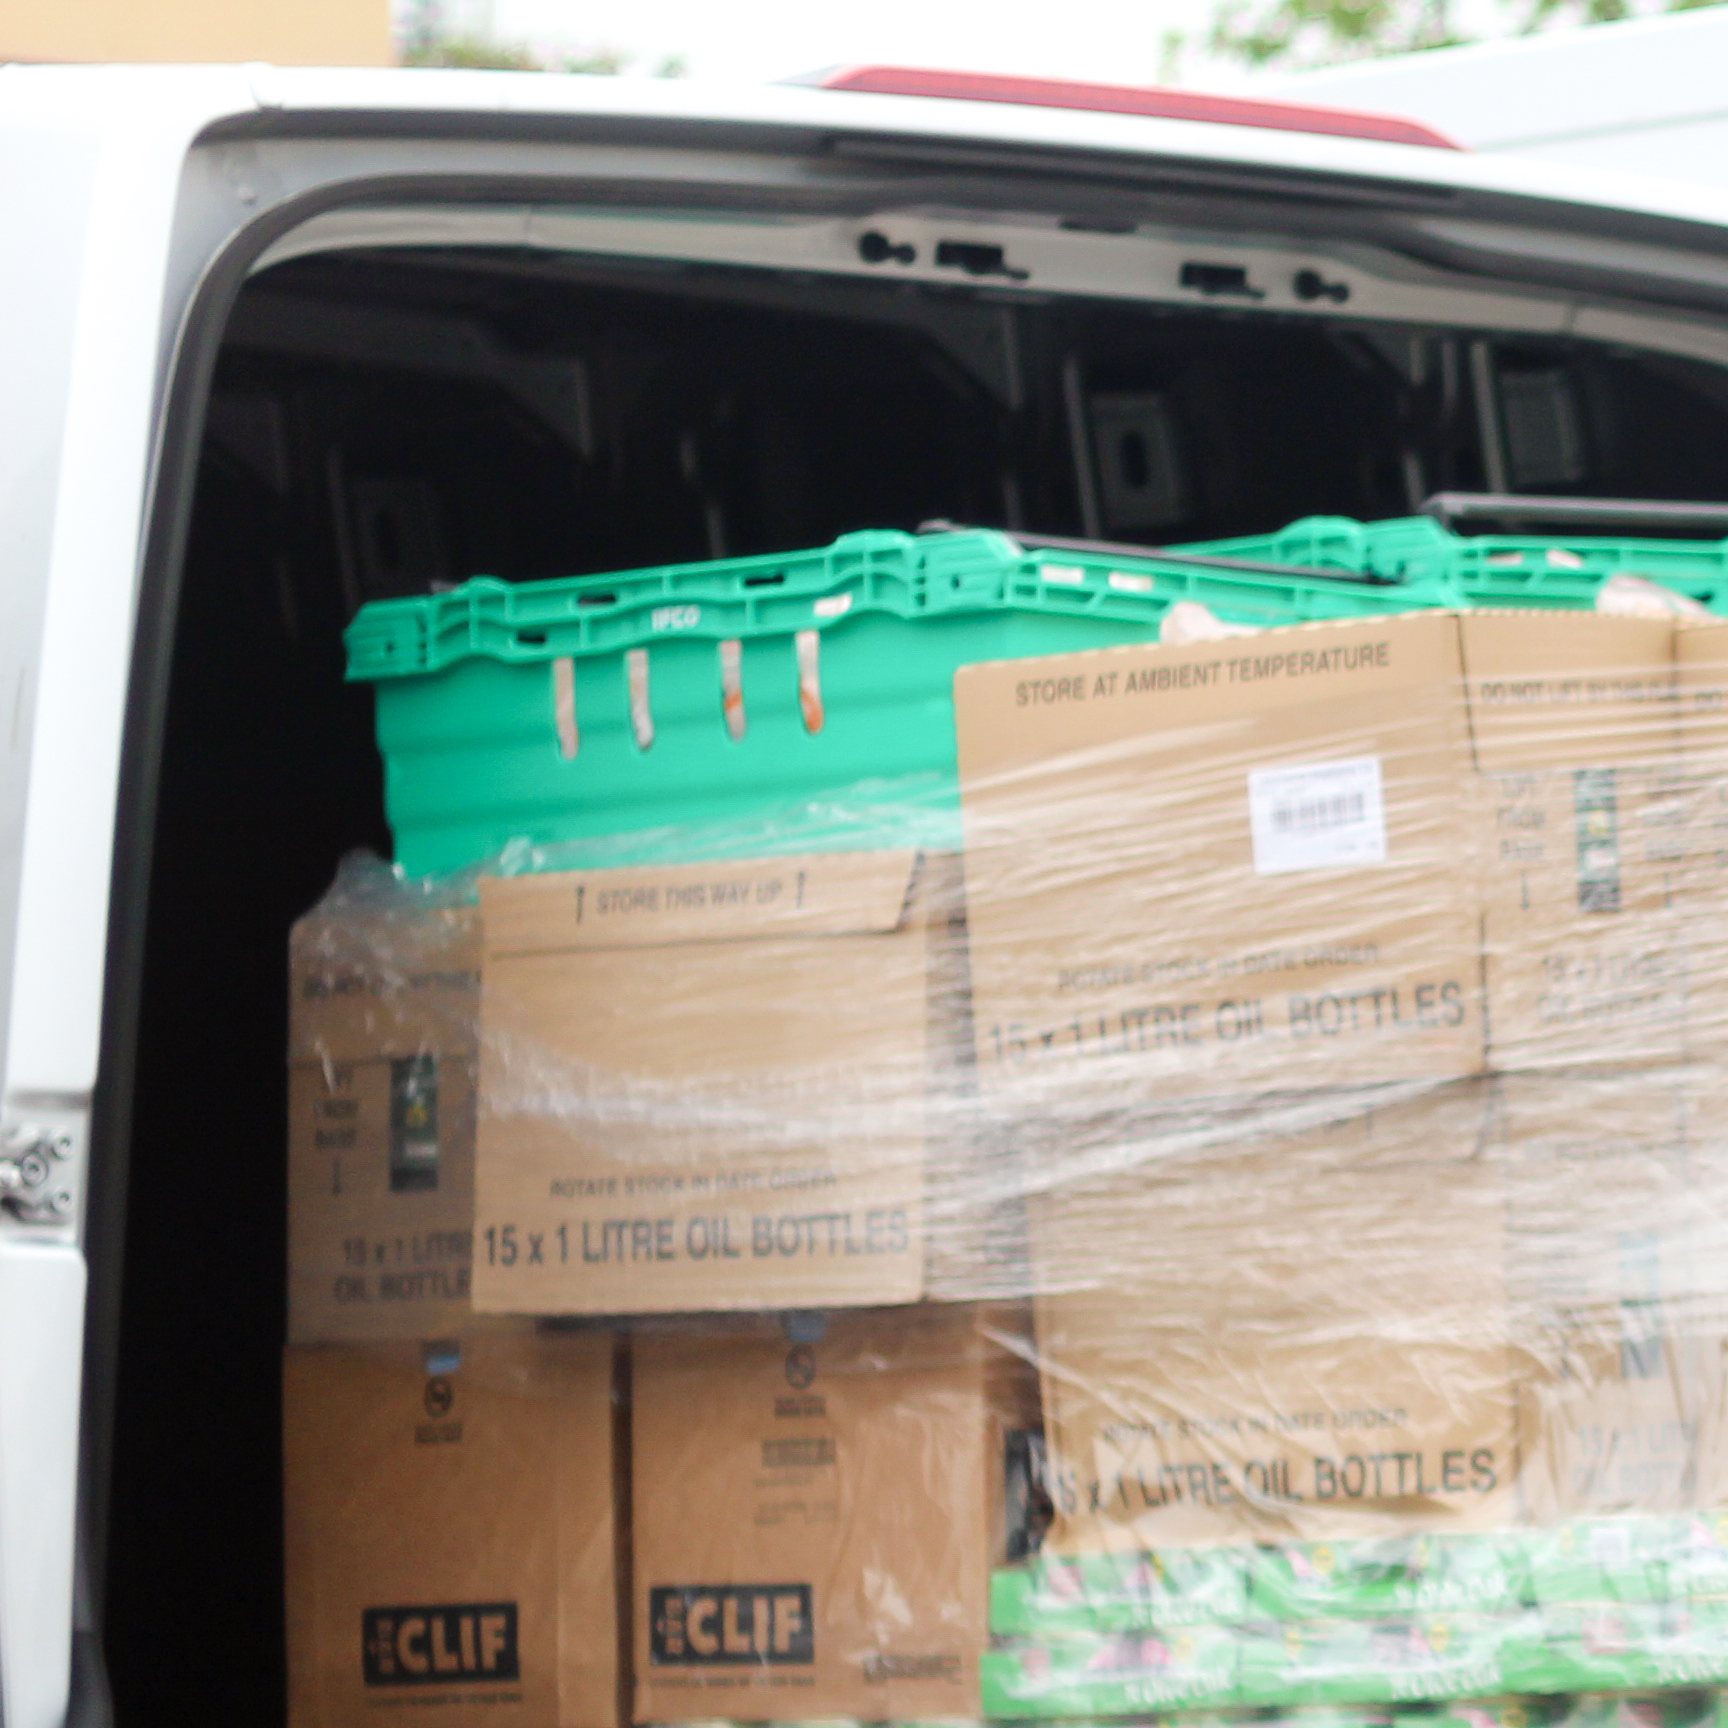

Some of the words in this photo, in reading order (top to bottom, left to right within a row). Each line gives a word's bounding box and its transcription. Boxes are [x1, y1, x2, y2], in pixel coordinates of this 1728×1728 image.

[1016, 675, 1085, 706] STORE
[1093, 672, 1118, 698] AT
[1125, 661, 1221, 694] AMBIENT
[1228, 642, 1391, 682] TEMPERATURE
[598, 887, 658, 914] STORE
[666, 885, 704, 911] THIS
[711, 880, 749, 906] WAY
[757, 879, 783, 904] UP
[990, 1023, 1026, 1066] 15
[1069, 1017, 1082, 1055] 1
[1100, 1003, 1202, 1056] LITRE
[1216, 1001, 1274, 1044] OIL
[1288, 981, 1465, 1039] BOTTLES
[484, 1225, 518, 1267] 15
[528, 1232, 544, 1265] x
[556, 1224, 568, 1264] 1
[582, 1218, 676, 1264] LITRE
[685, 1216, 740, 1261] OIL
[750, 1210, 911, 1258] BOTTLES
[1138, 1462, 1231, 1507] LITRE
[1243, 1459, 1303, 1502] OIL
[1315, 1449, 1497, 1499] BOTTLES
[397, 1614, 507, 1675] CLIF
[686, 1595, 802, 1657] CLIF
